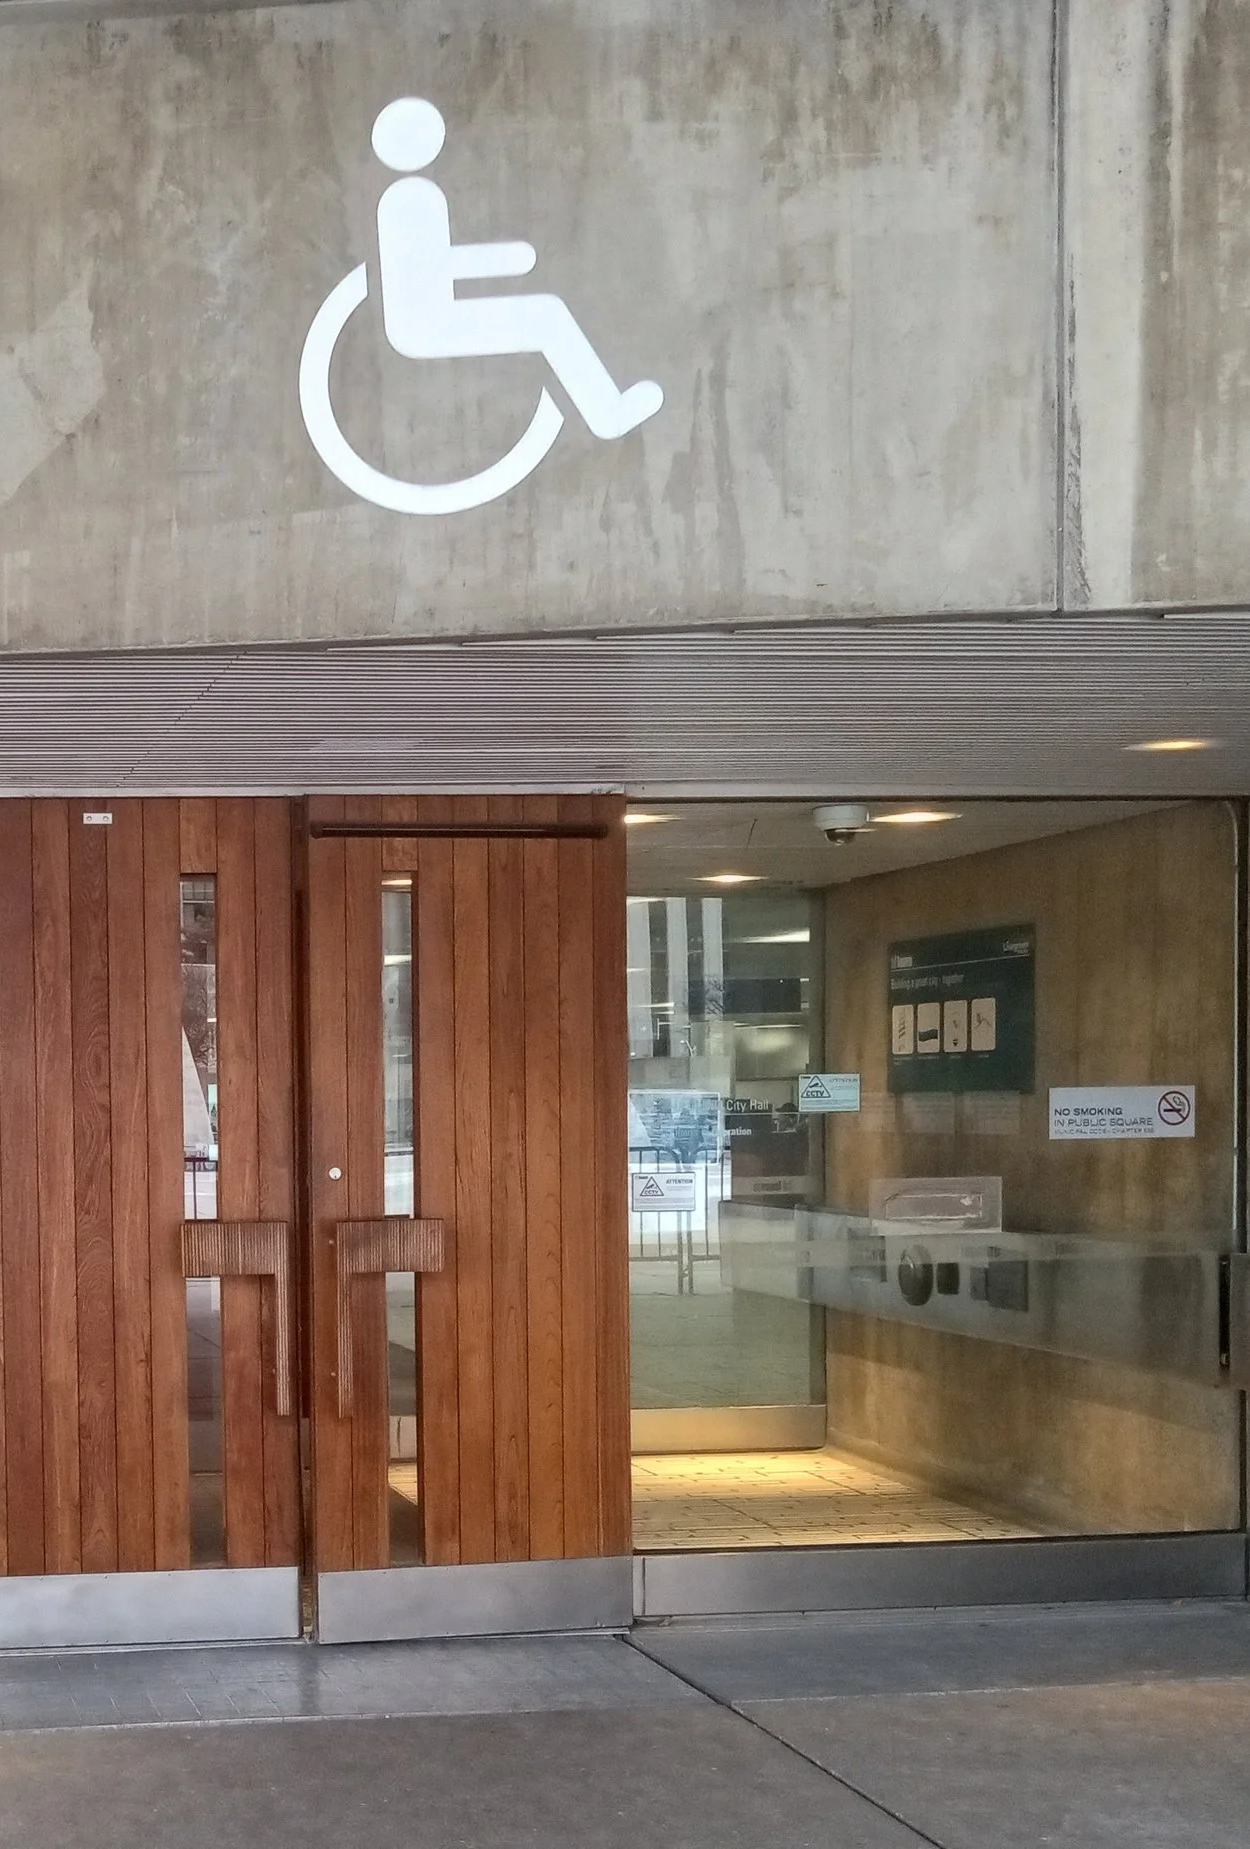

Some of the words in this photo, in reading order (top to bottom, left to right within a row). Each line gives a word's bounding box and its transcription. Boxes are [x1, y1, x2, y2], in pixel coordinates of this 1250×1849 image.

[726, 1099, 747, 1113] City
[749, 1099, 769, 1111] Hall
[1054, 1107, 1071, 1117] NO
[1073, 1106, 1124, 1117] SMOKING
[1054, 1118, 1065, 1128] IN
[1067, 1118, 1107, 1128] PUBLIC
[1109, 1117, 1154, 1127] SQUARE
